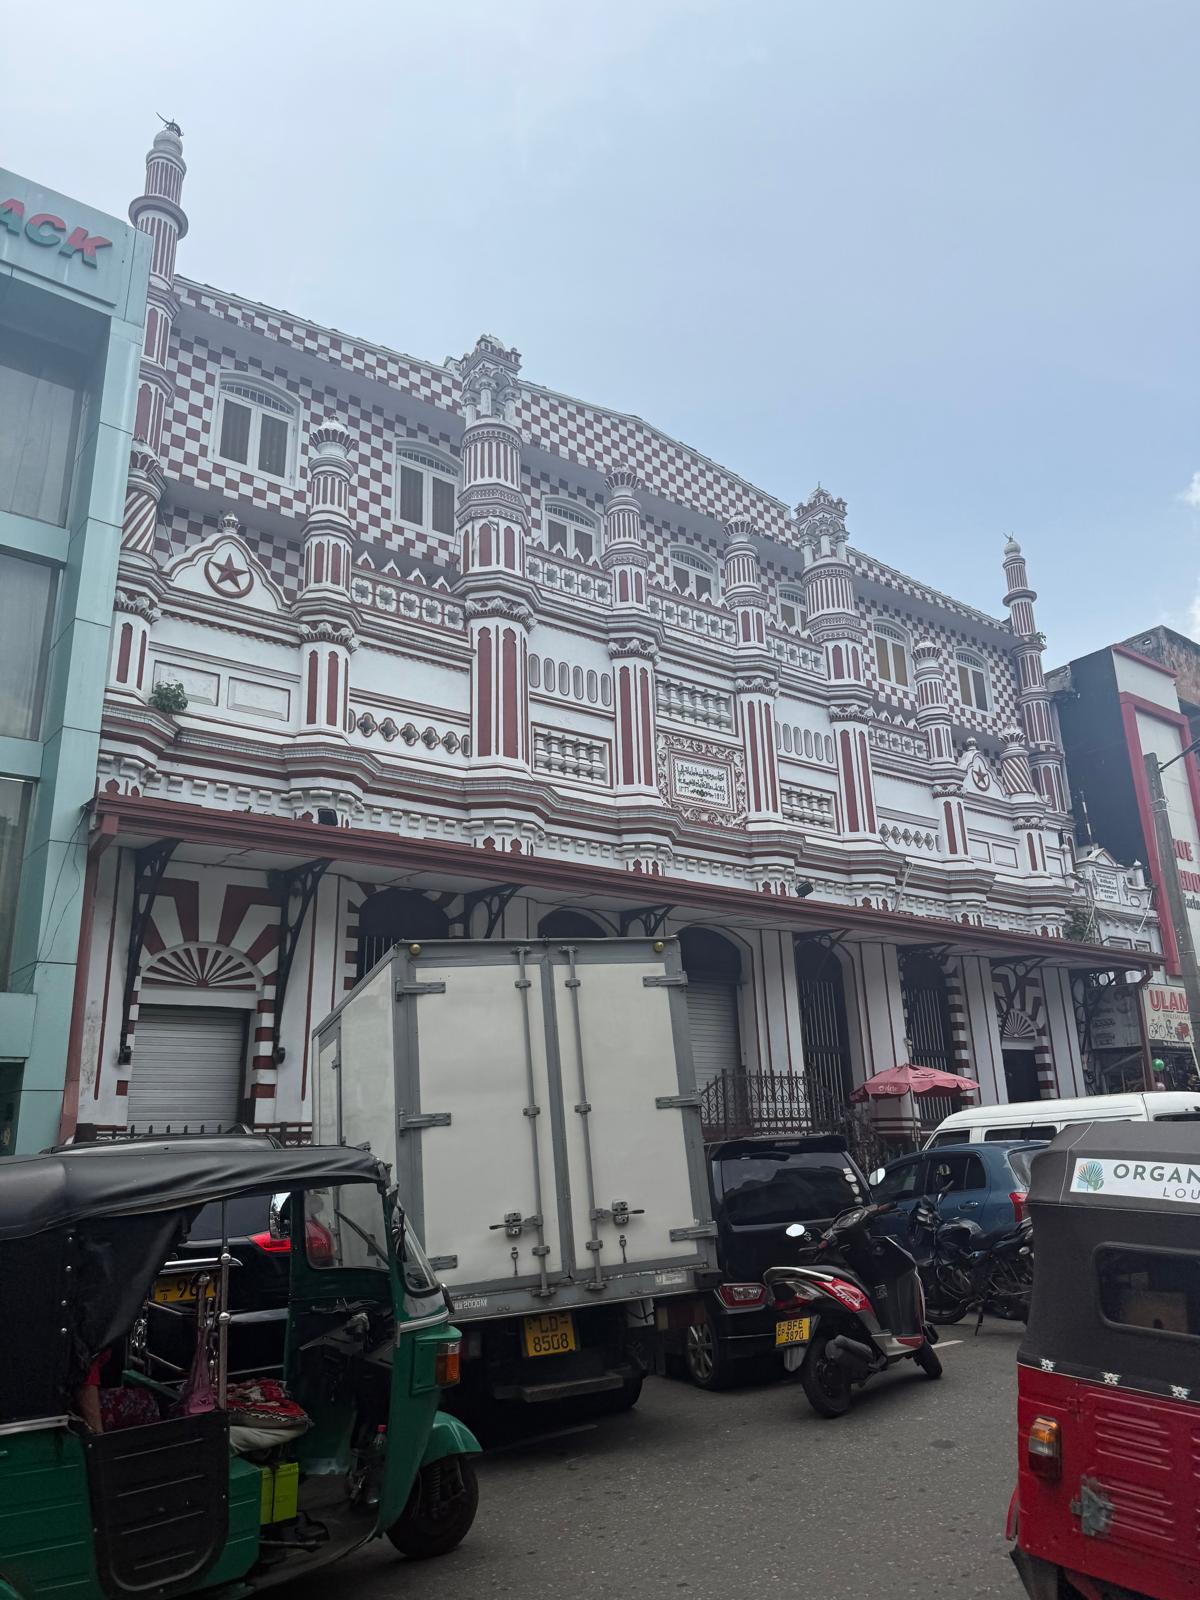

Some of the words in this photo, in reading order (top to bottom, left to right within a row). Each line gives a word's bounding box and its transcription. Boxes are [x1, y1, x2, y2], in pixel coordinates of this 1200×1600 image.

[0, 198, 113, 270] ACK
[1162, 1186, 1200, 1200] LOU
[787, 1320, 803, 1330] BFE
[533, 1333, 569, 1352] 8508
[785, 1330, 804, 1341] 3870
